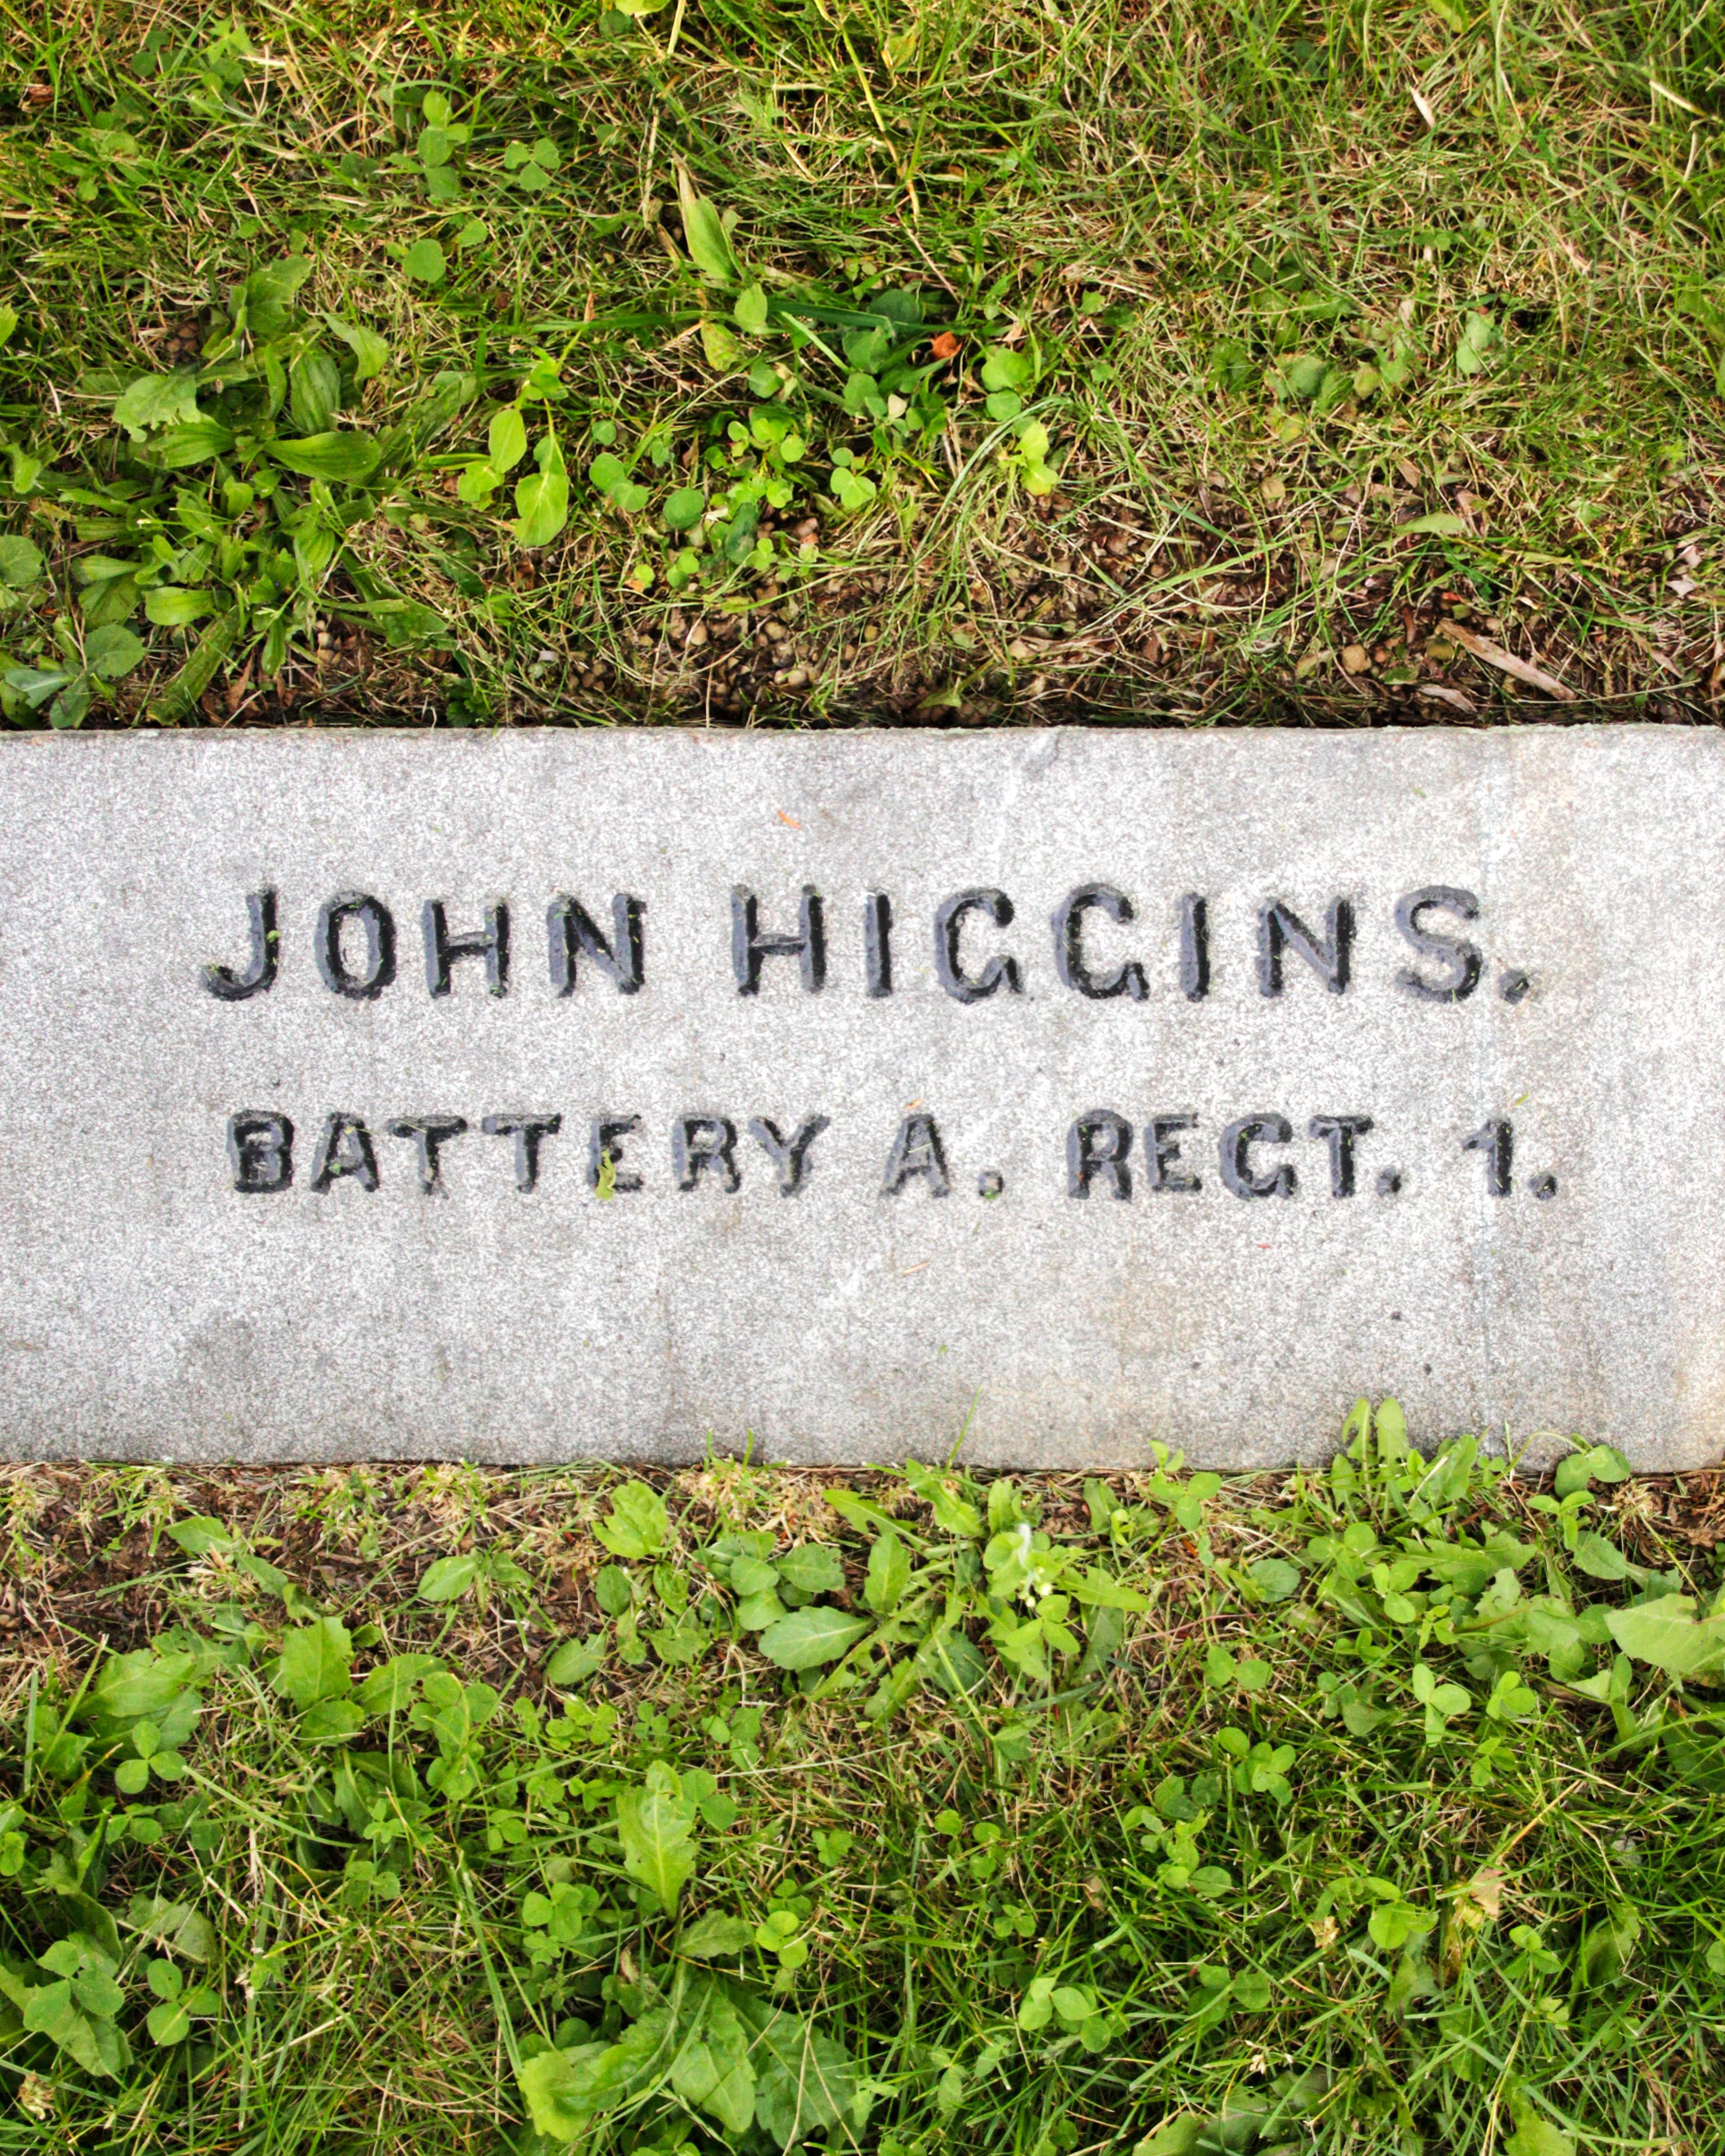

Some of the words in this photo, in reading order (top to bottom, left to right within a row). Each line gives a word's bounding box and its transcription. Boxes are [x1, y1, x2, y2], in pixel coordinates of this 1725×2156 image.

[201, 888, 646, 1001] JOHN
[731, 885, 1536, 1005] HIGGINS.
[228, 1109, 832, 1198] BATTERY
[881, 1112, 1006, 1199] A.
[1069, 1108, 1402, 1202] REGT.
[1463, 1117, 1561, 1199] 1.
